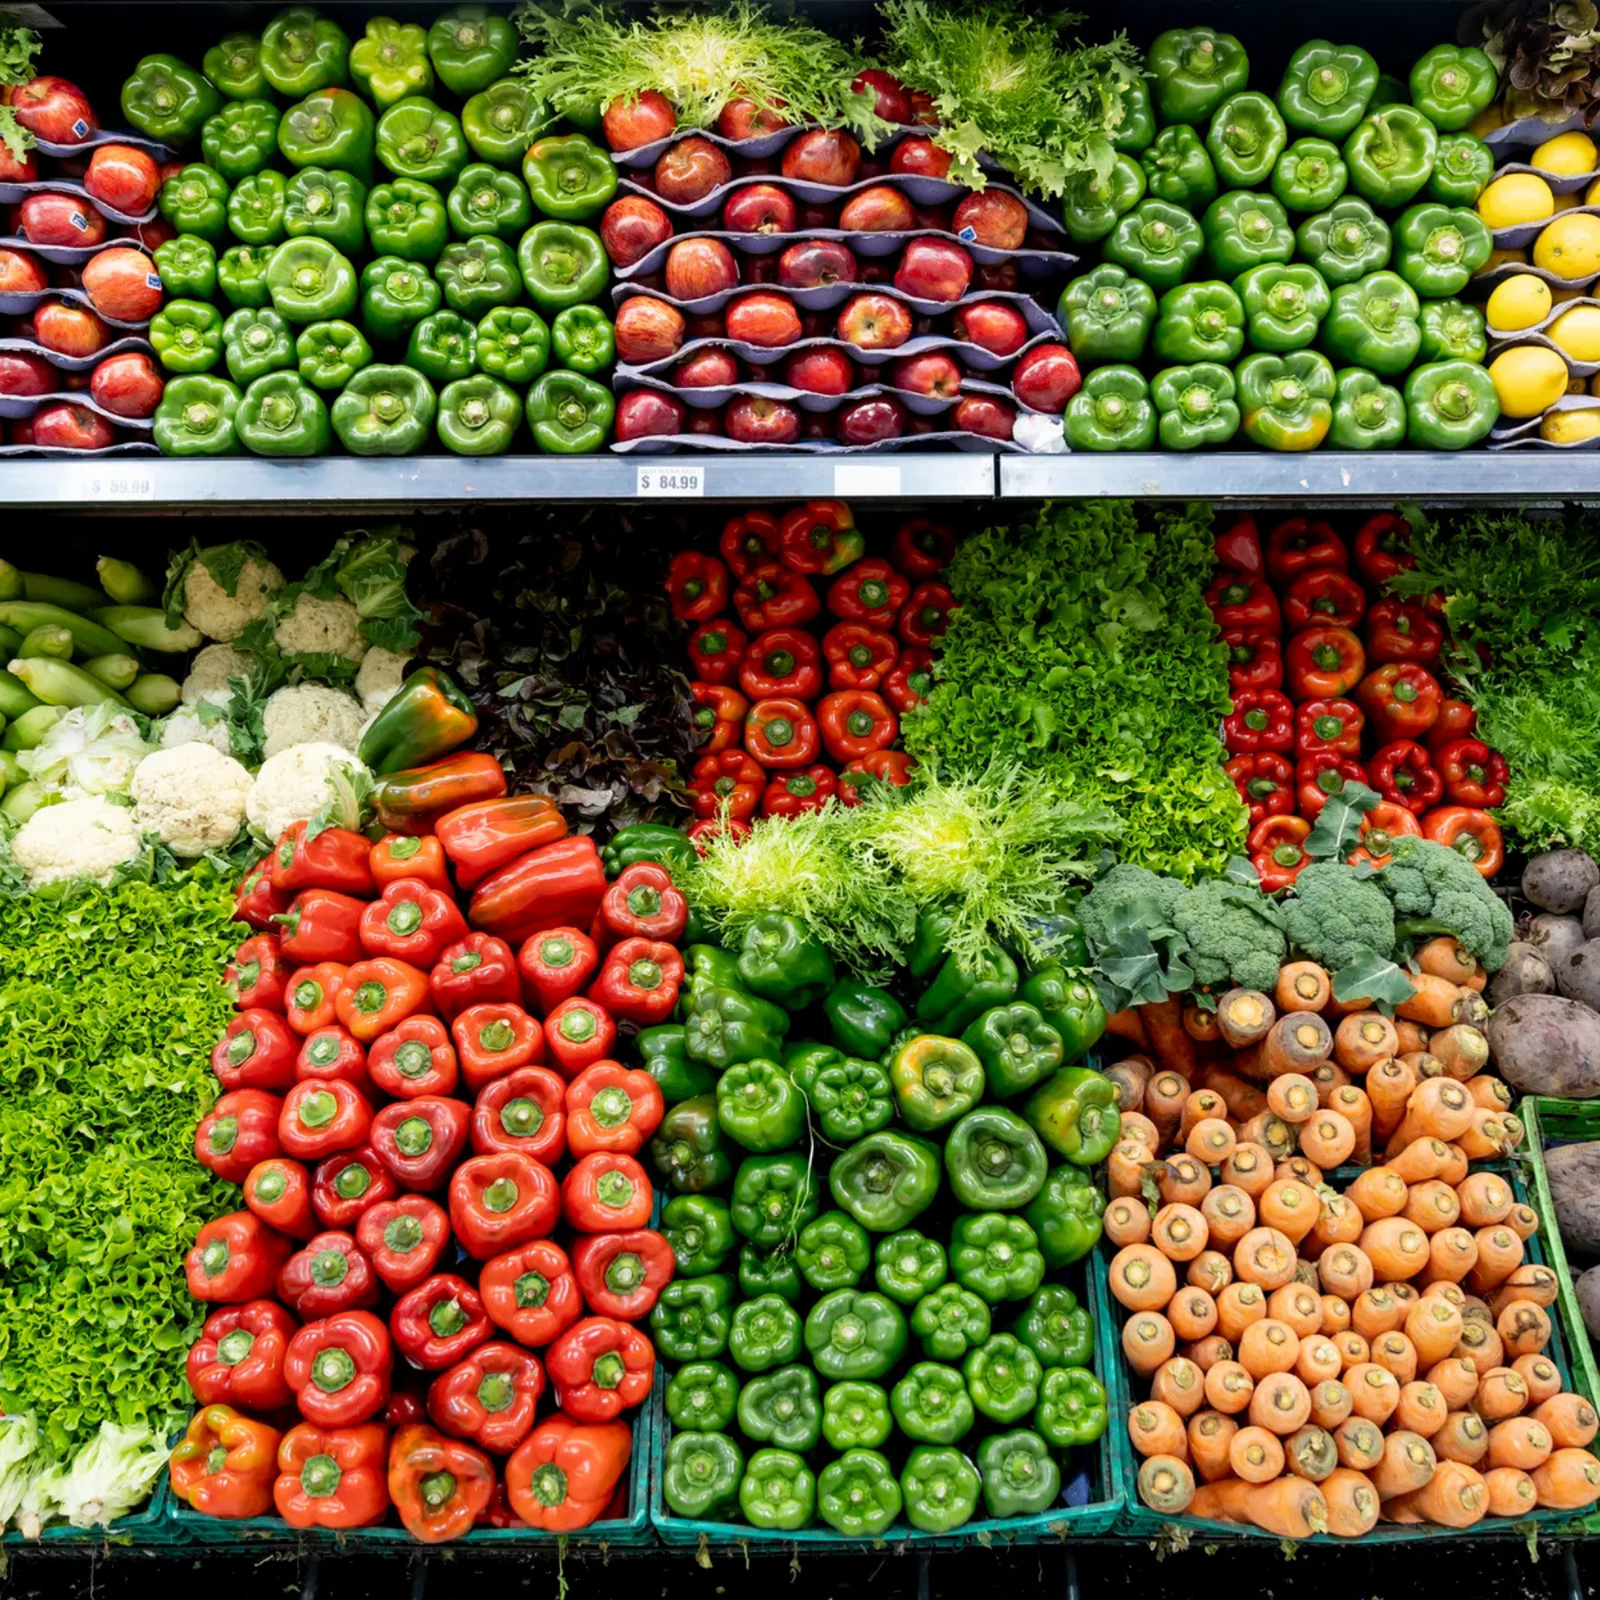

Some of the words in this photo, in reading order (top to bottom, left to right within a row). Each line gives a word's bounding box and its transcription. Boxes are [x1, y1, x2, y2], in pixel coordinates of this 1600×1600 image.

[110, 480, 149, 494] 59.99
[641, 475, 650, 489] $
[659, 475, 698, 489] 84.99
